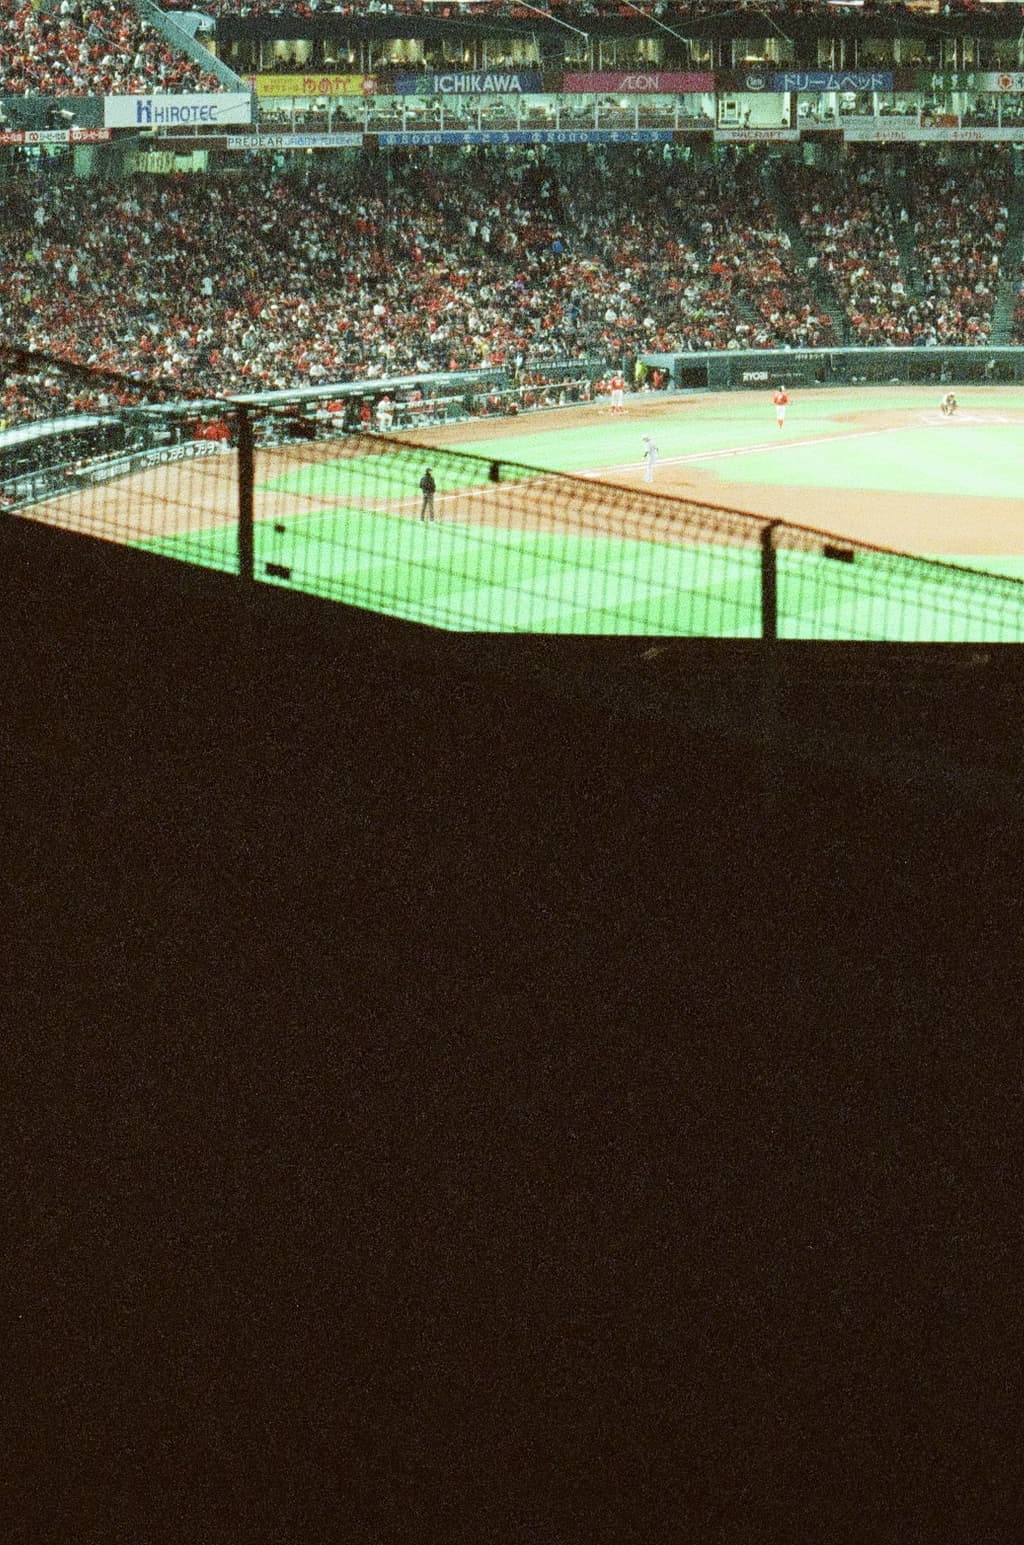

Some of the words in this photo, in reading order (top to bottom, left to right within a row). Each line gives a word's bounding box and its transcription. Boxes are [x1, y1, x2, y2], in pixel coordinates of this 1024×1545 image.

[433, 74, 522, 93] ICHIKAWA
[784, 74, 883, 91] ドリームベッド
[154, 105, 218, 123] HIROTEC
[227, 136, 283, 146] PREDEAR
